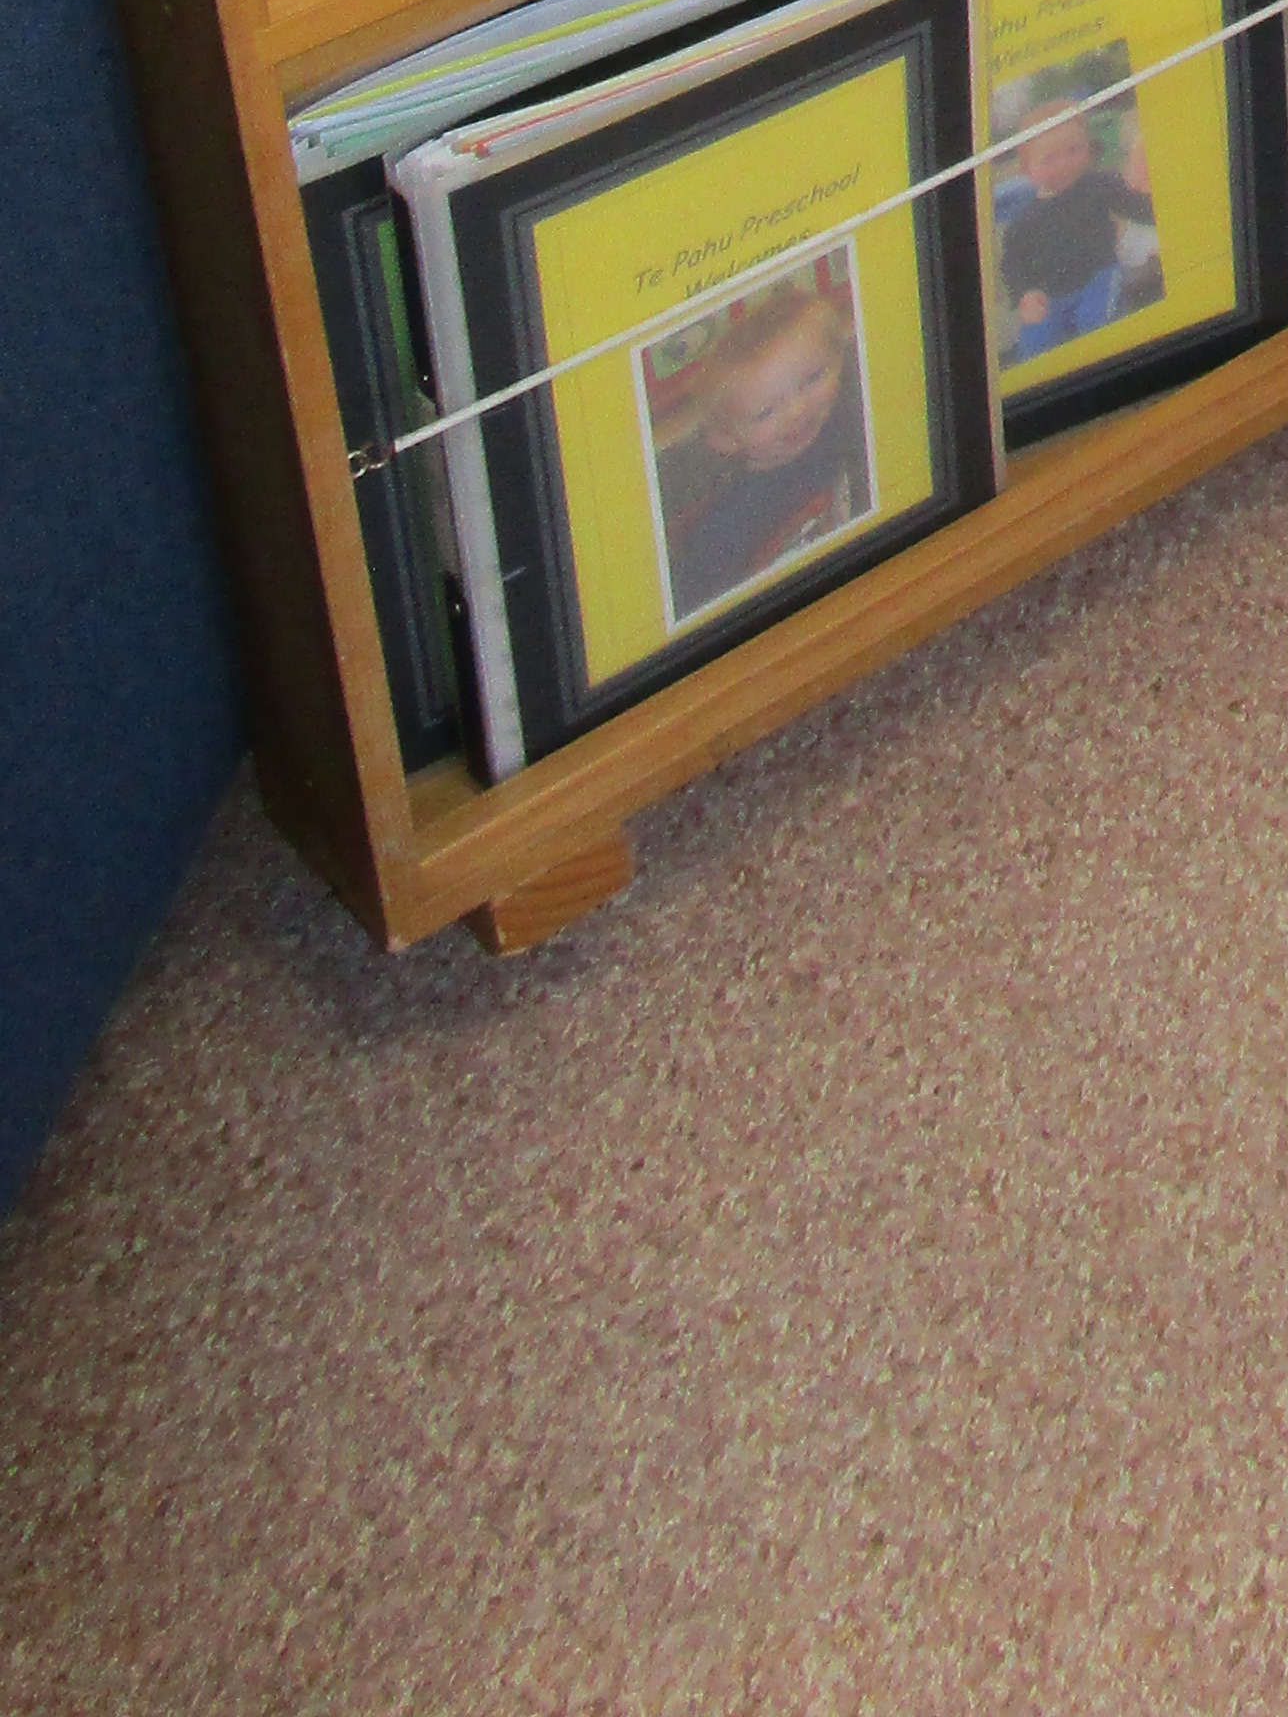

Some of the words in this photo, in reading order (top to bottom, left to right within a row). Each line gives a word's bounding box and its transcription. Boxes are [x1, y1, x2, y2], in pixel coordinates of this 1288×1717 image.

[988, 14, 1028, 42] ahu
[632, 267, 664, 295] Te
[671, 229, 734, 277] Pahu
[740, 161, 862, 241] Preschool
